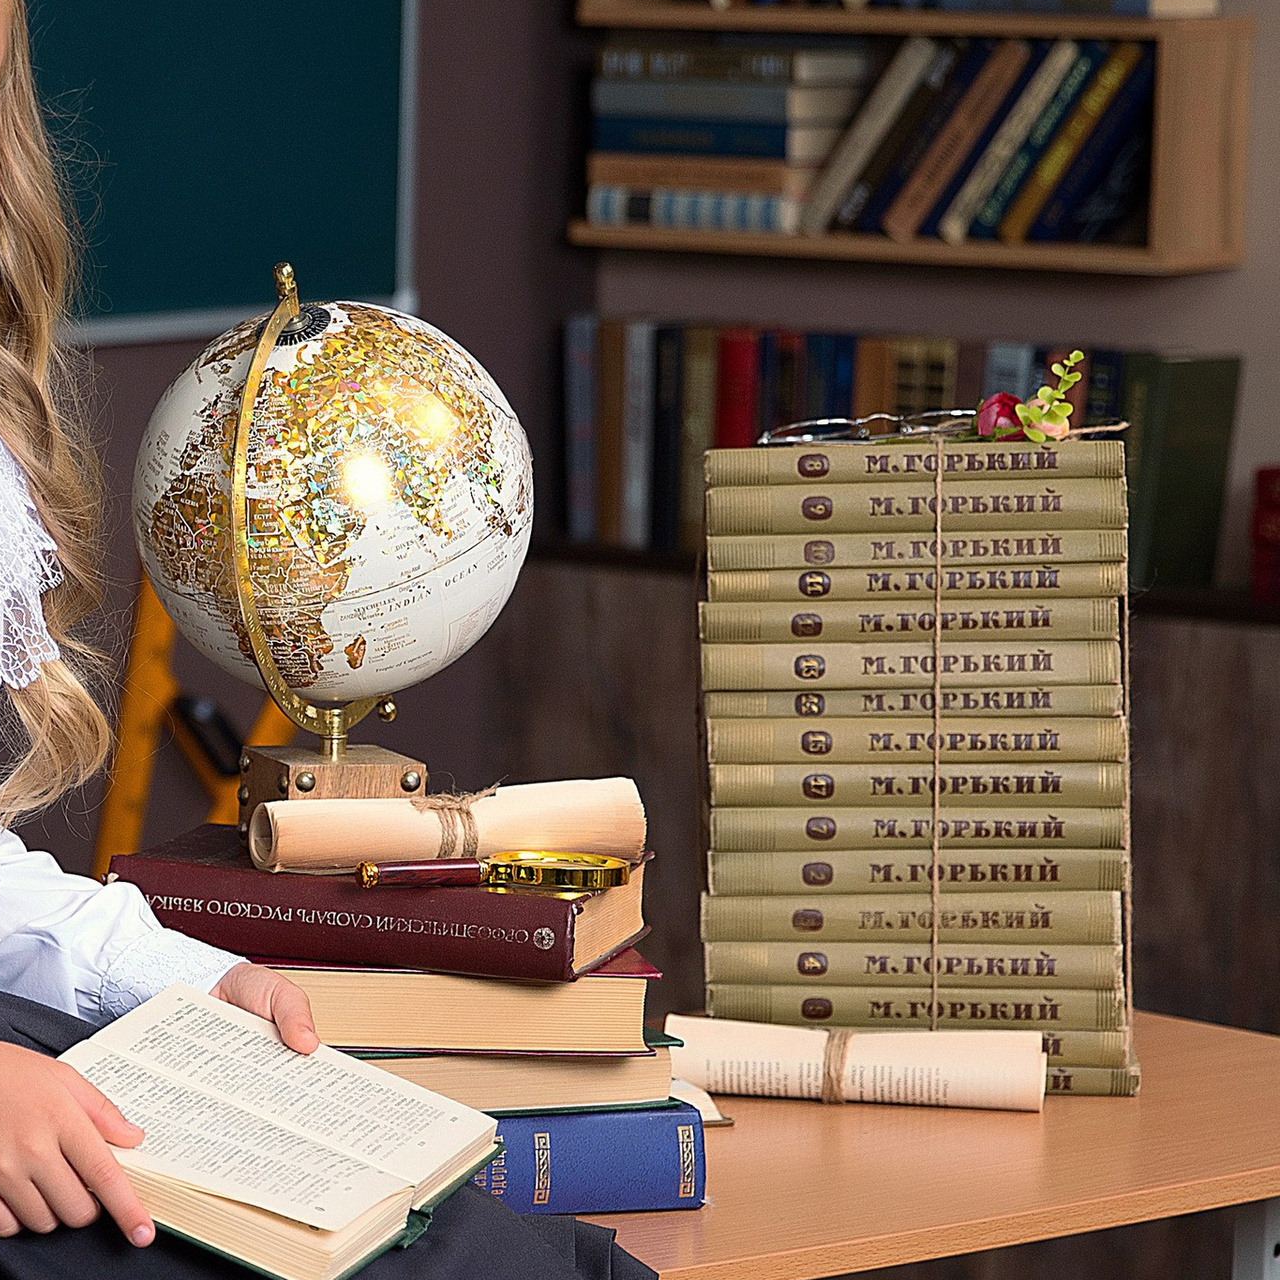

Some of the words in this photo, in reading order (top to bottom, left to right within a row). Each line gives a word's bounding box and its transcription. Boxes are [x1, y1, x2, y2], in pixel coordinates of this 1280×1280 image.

[864, 445, 1059, 474] М.ГОРЬКИЙ
[869, 487, 1063, 517] М.ГОРЬКИЙ
[871, 533, 1063, 561] М.ГОРЬКИЙ
[444, 563, 480, 588] OCEAN
[867, 565, 1061, 592] М.ГОРЬКИЙ
[388, 588, 433, 613] INDIAN
[859, 605, 1053, 633] М.ГОРЬКИЙ
[861, 648, 1054, 676] М.ГОРЬКИЙ
[861, 687, 1054, 713] М.ГОРЬКИЙ
[868, 728, 1061, 753] М.ГОРЬКИЙ
[870, 771, 1063, 796] М.ГОРЬКИЙ
[873, 815, 1066, 839] М.ГОРЬКИЙ
[870, 856, 1061, 884] М.ГОРЬКИЙ
[207, 900, 293, 923] РУССКОГО
[296, 907, 373, 930] СЛОВАРЬ
[376, 914, 530, 944] ОРФОЭПИЧЕСКИЙ
[864, 951, 1059, 977] М.ГОРЬКИЙ
[868, 996, 1062, 1021] М.ГОРЬКИЙ
